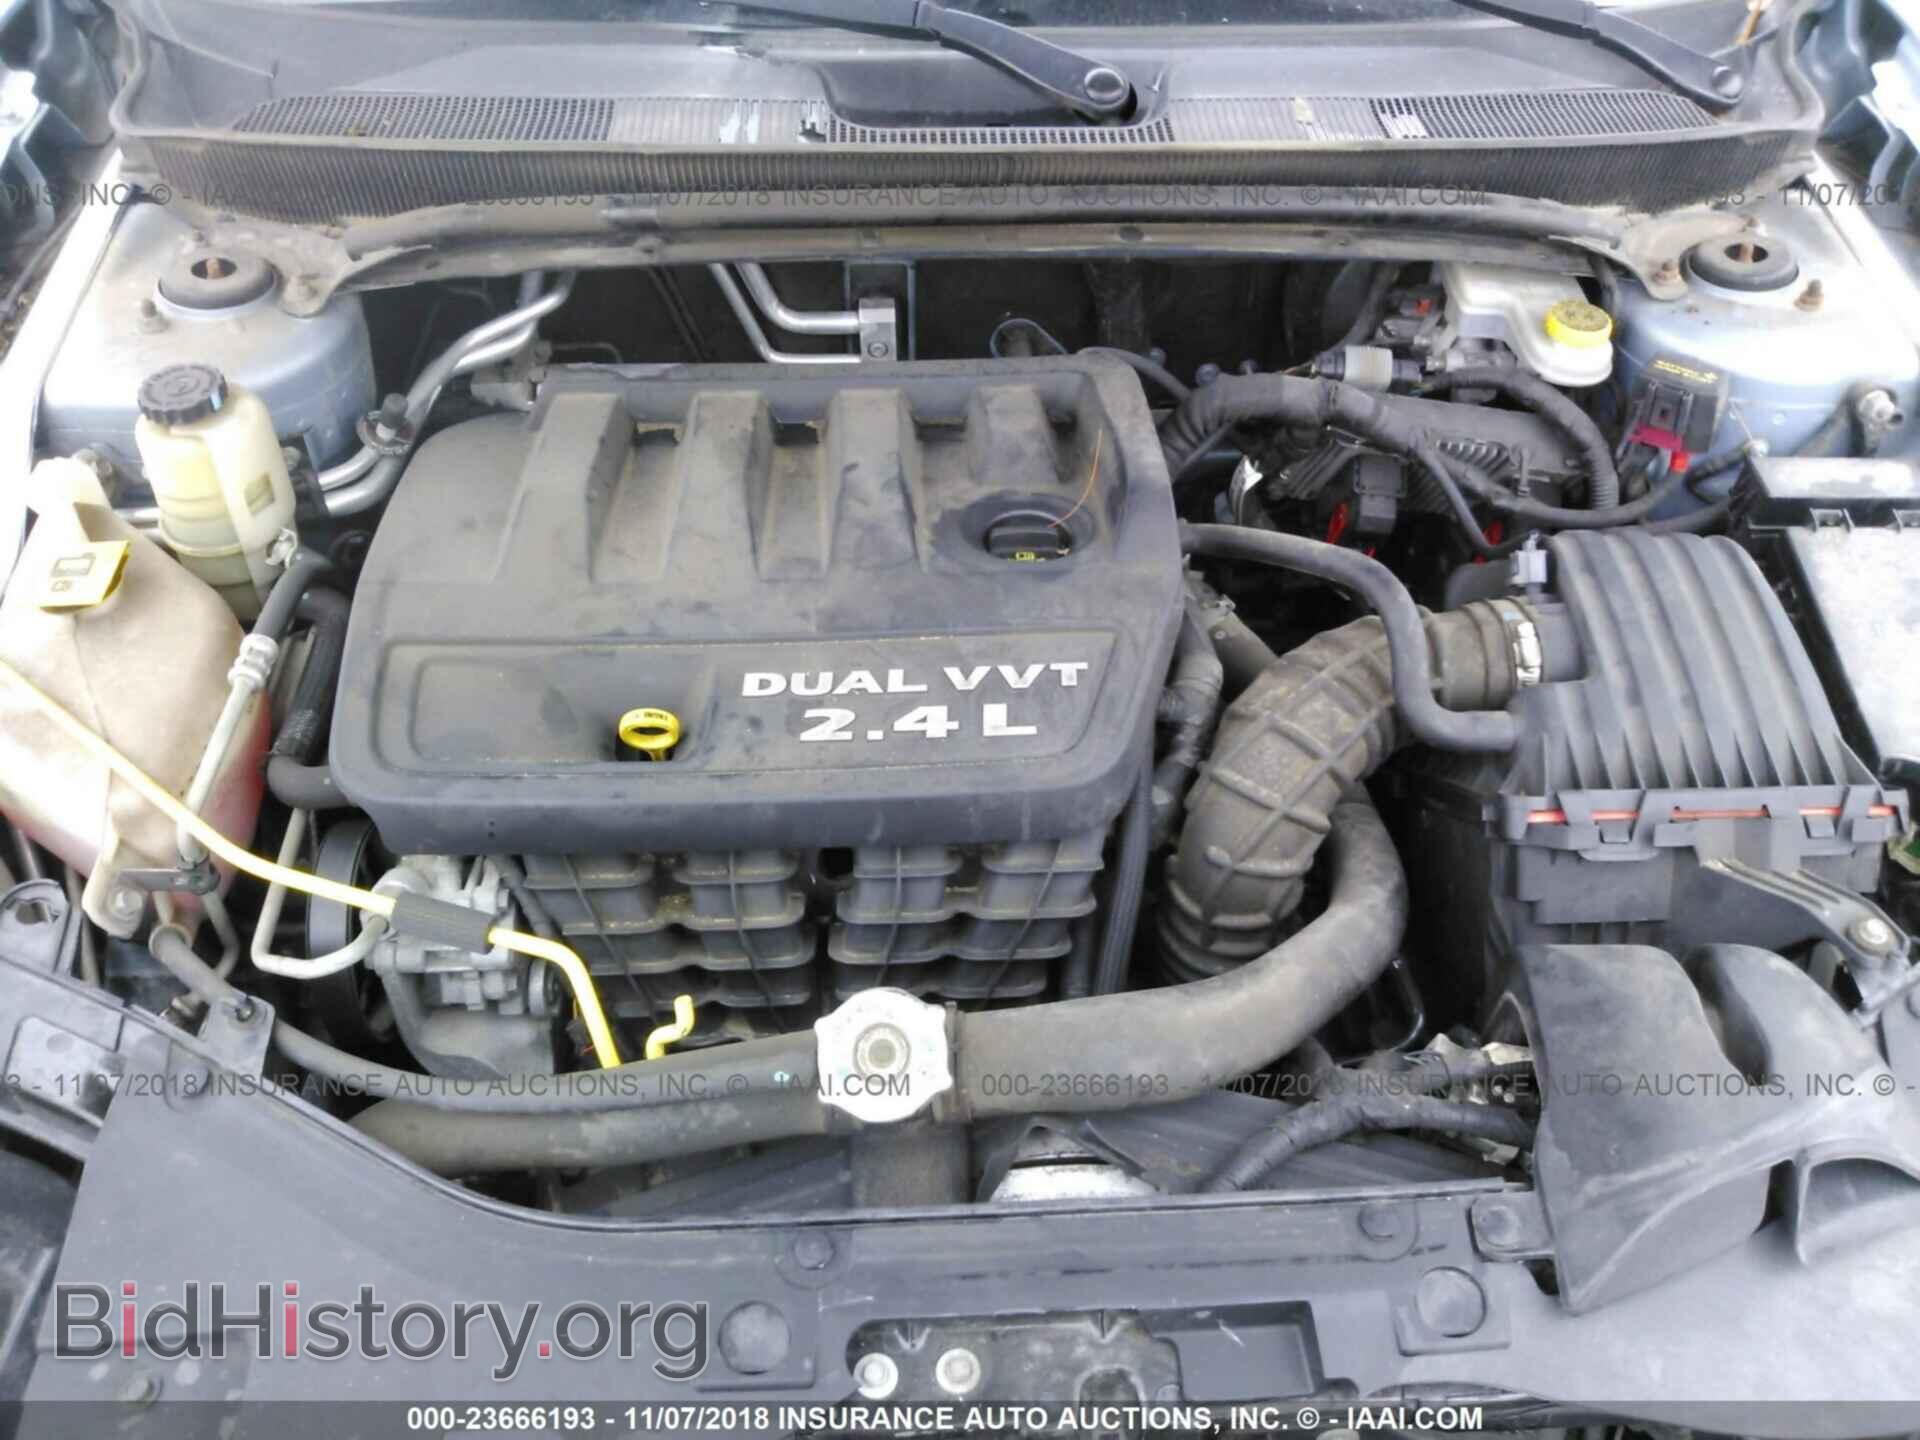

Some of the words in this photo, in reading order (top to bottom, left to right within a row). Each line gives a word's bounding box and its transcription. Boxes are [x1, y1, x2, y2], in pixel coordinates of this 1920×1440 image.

[742, 669, 928, 697] DUAL
[943, 662, 1088, 691] VVT
[799, 705, 960, 742] 2.4
[982, 703, 1038, 737] L
